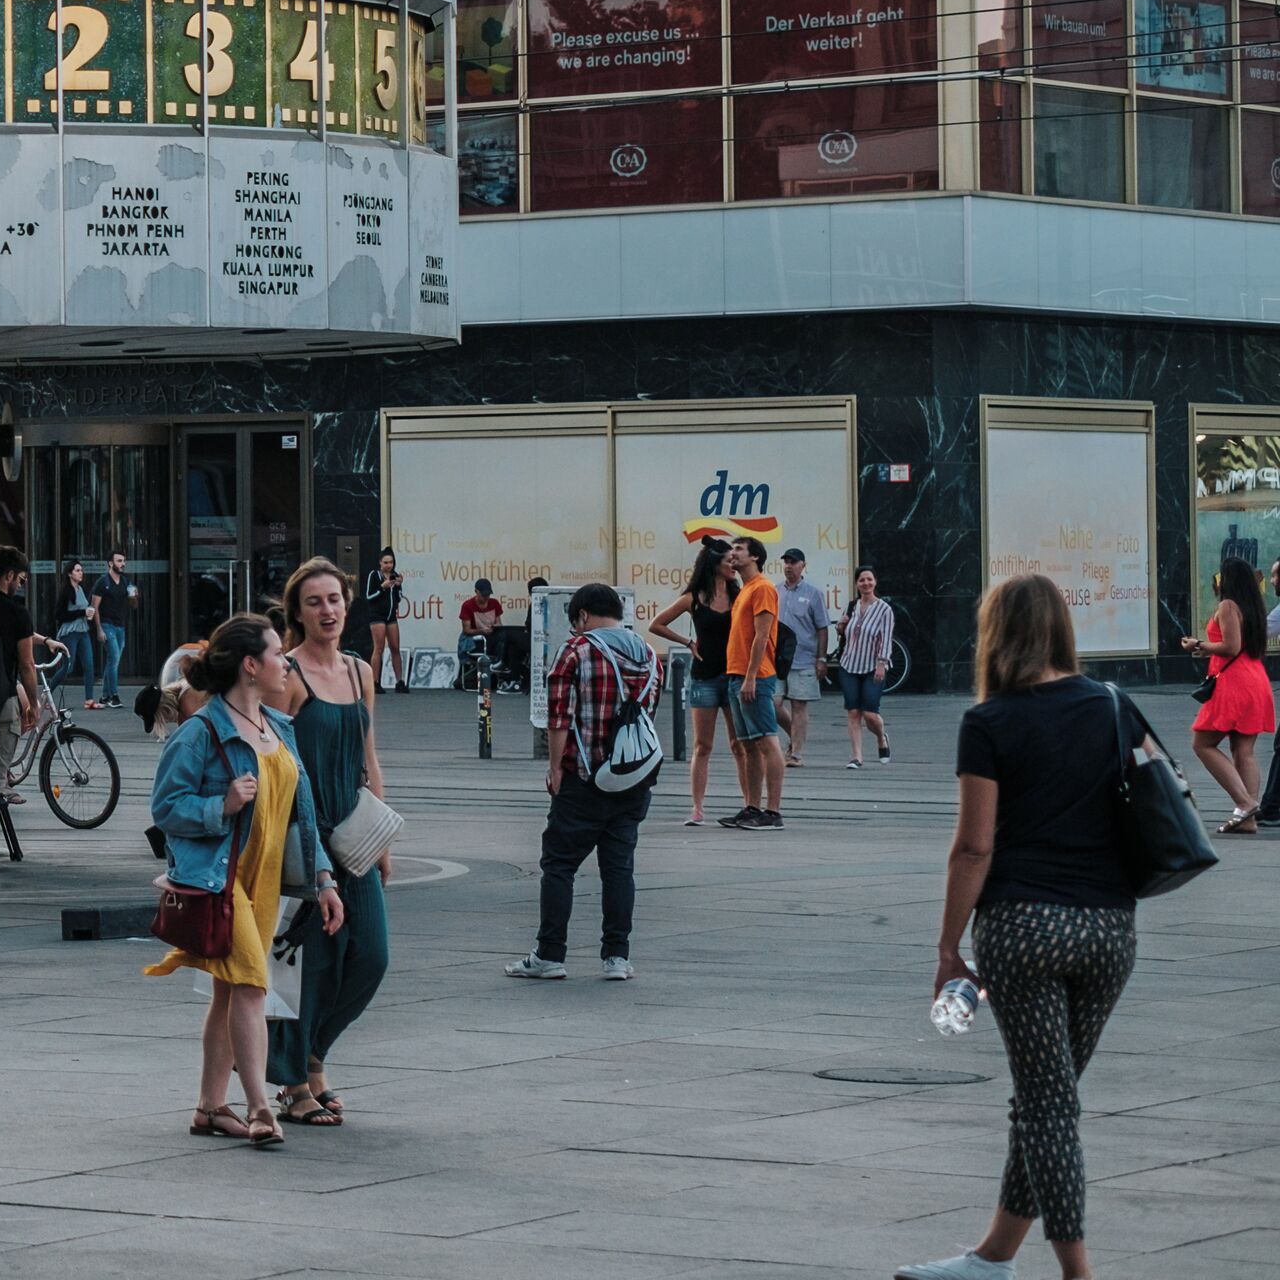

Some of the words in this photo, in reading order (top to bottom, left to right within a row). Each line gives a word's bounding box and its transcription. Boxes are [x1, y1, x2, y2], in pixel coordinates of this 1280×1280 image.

[765, 16, 794, 32] Der
[799, 9, 863, 29] Verkauf
[866, 7, 904, 28] geht
[1044, 13, 1060, 30] Wir
[1062, 16, 1088, 34] bauen
[1090, 21, 1106, 37] um!
[550, 32, 602, 48] Please
[605, 28, 660, 43] excuse
[664, 28, 681, 40] us
[806, 32, 863, 52] weiter!
[44, 5, 110, 90] 2
[184, 10, 234, 97] 3
[289, 19, 335, 101] 4
[559, 57, 582, 69] we
[586, 54, 610, 68] are
[614, 44, 691, 67] changing!
[373, 29, 398, 111] 5
[825, 138, 850, 155] C&A
[617, 152, 640, 168] C&A
[246, 171, 289, 186] PEKING
[111, 187, 159, 201] HANOI
[235, 189, 300, 206] SHANGHAI
[343, 192, 393, 212] PJÖNGJANG
[102, 205, 169, 220] BANGKOK
[244, 208, 292, 223] MANILA
[356, 213, 381, 228] TOKYO
[87, 223, 139, 238] PHNOM
[147, 224, 185, 239] PENH
[250, 227, 287, 240] PERTH
[356, 231, 382, 246] SEOUL
[102, 242, 170, 256] JAKARTA
[235, 244, 302, 259] HONGKONG
[223, 262, 262, 277] KUALA
[268, 263, 314, 278] LUMPUR
[238, 281, 298, 296] SINGAPUR
[699, 470, 770, 517] dm
[1117, 534, 1139, 553] Foto
[440, 560, 551, 581] Wohlfühlen
